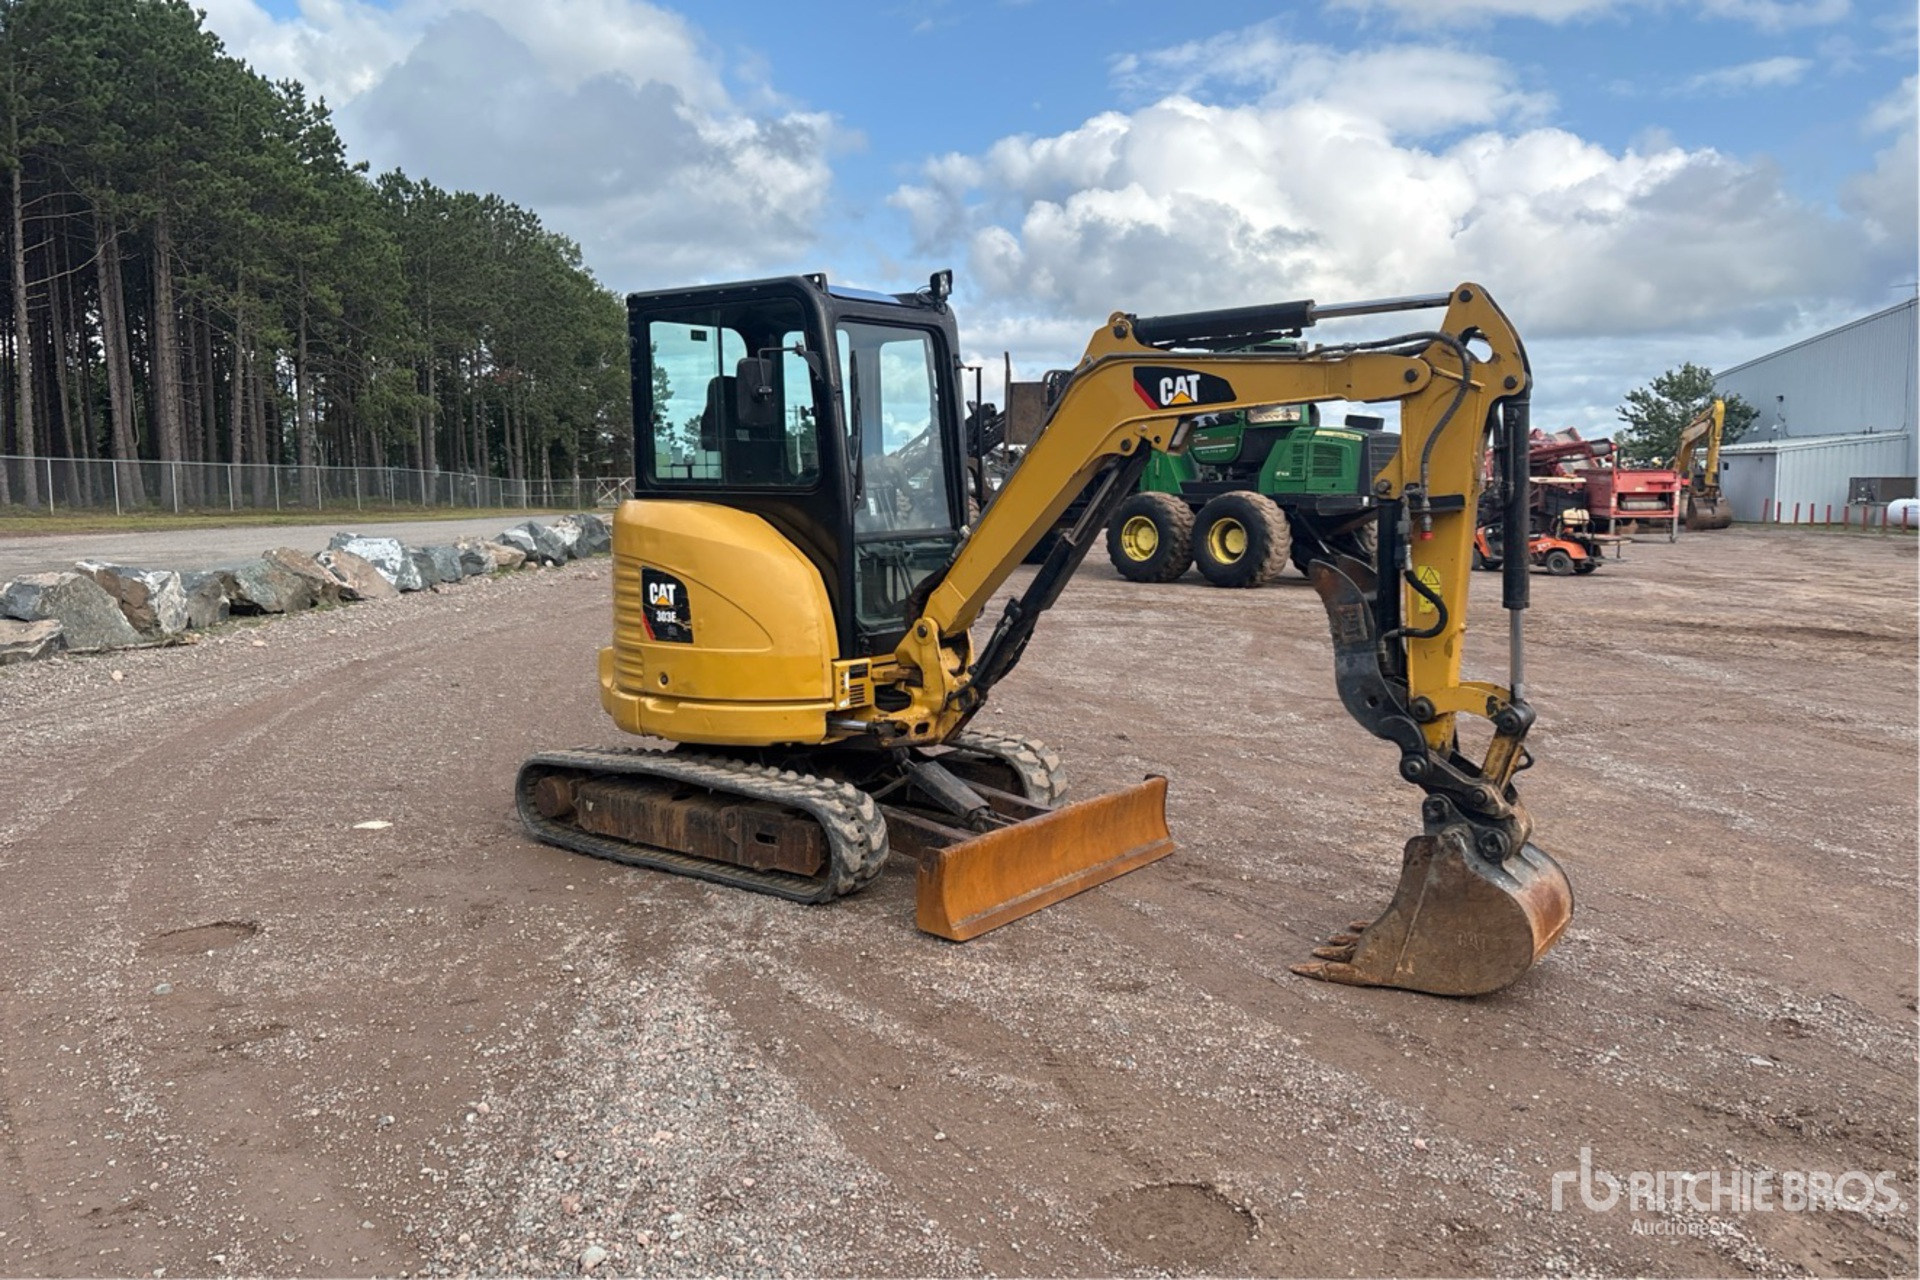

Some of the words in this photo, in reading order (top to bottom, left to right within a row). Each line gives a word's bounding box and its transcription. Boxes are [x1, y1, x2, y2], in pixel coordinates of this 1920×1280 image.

[1159, 374, 1201, 406] CAT
[649, 582, 676, 606] CAT
[656, 610, 676, 623] 303E
